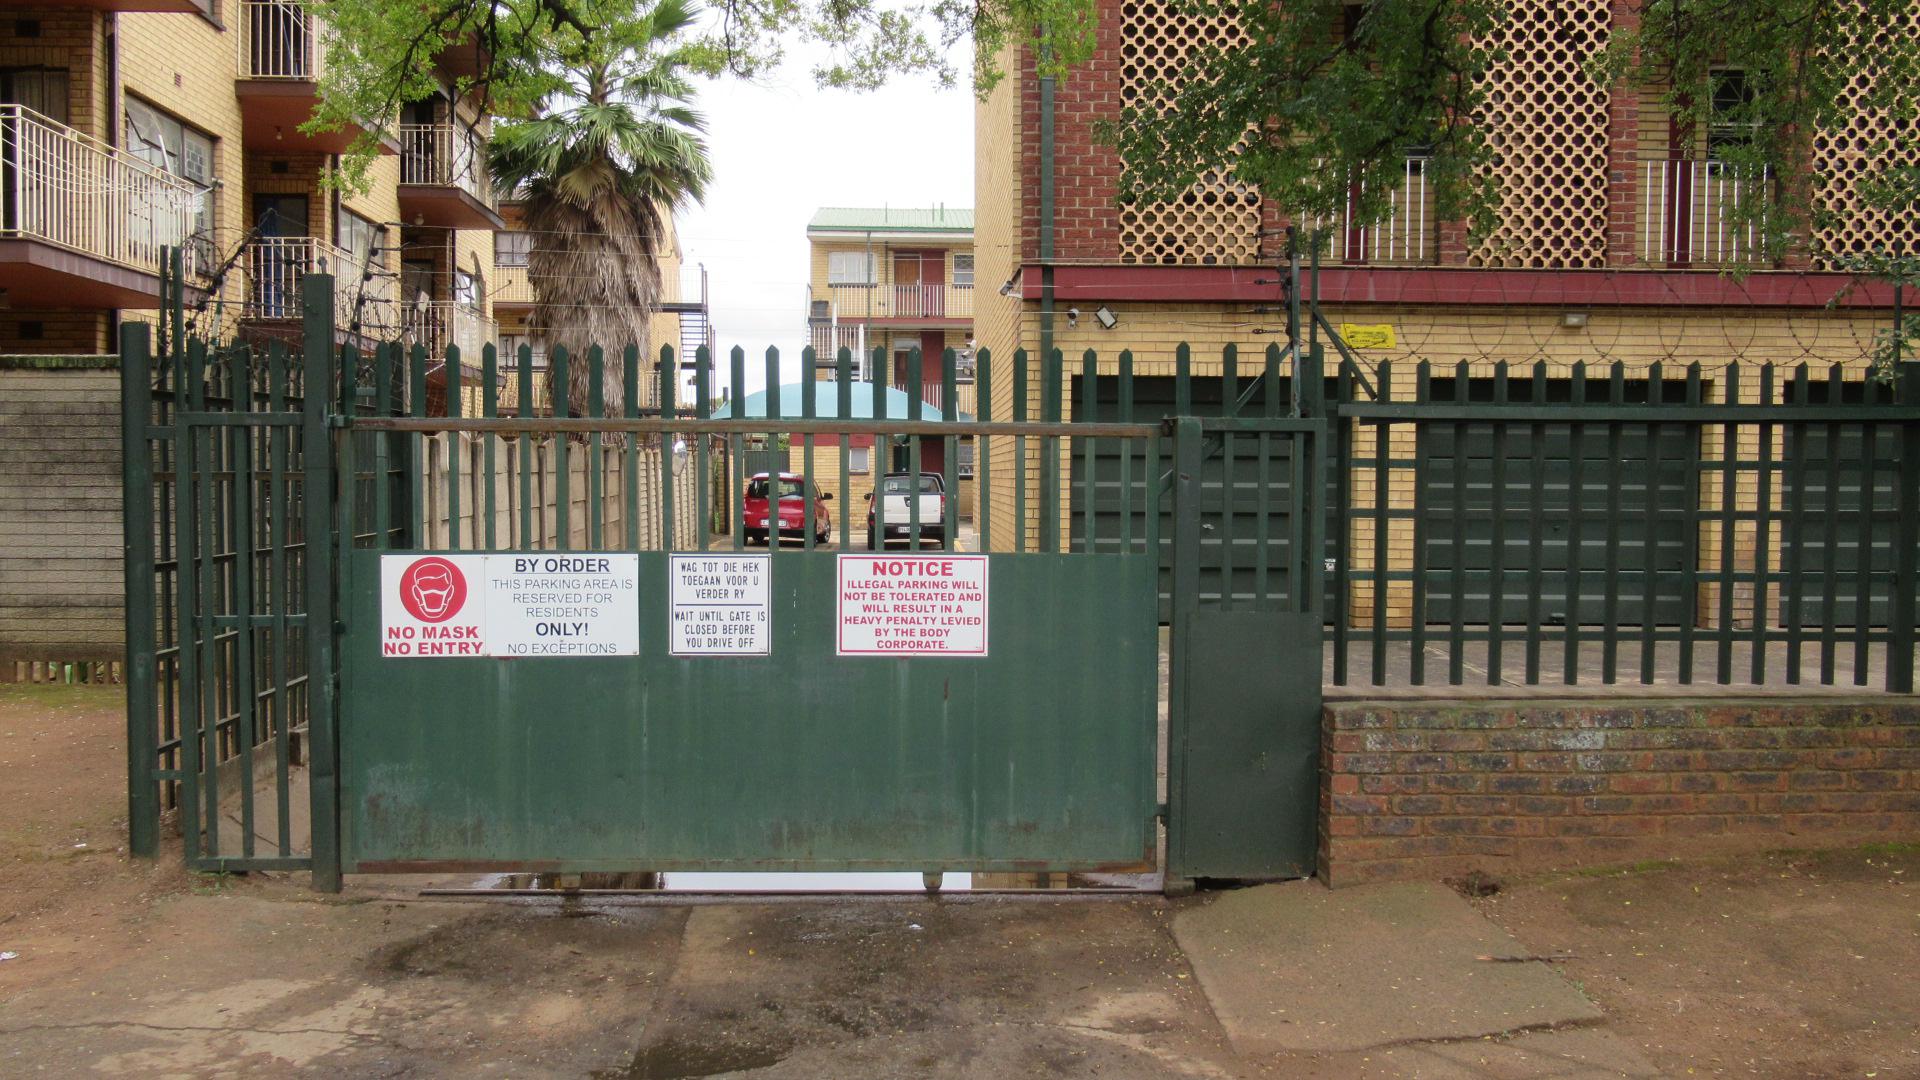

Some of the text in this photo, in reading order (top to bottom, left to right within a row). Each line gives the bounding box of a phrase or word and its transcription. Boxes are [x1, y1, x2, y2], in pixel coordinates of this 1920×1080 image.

[515, 559, 610, 572] BY ORDER
[681, 562, 759, 572] WAG TOT DIE HEK
[873, 561, 953, 576] NOTICE
[492, 579, 632, 589] THIS PARKING AREA IS
[682, 575, 759, 586] TOEGAAN VOOR U
[848, 580, 978, 589] ILLEGAL PARKING WILL
[513, 593, 612, 603] RESERVED FOR
[696, 589, 744, 599] VERDER RY
[844, 592, 982, 602] NOT BE TOLERATED AND
[527, 608, 598, 617] RESIDENTS
[862, 604, 963, 613] WILL RESULT IN A
[675, 611, 765, 621] WAIT UNTIL GATE IS
[845, 616, 981, 626] HEAVY PENALTY LEVIED
[388, 626, 479, 639] NO MASK
[536, 622, 588, 636] ONLY!
[685, 624, 755, 635] CLOSED BEFORE
[875, 628, 950, 637] BY THE BODY
[686, 638, 754, 648] YOU DRIVE OFF
[876, 640, 949, 649] CORPORATE.
[384, 642, 484, 655] NO ENTRY
[508, 643, 616, 654] NO EXCEPTIONS
